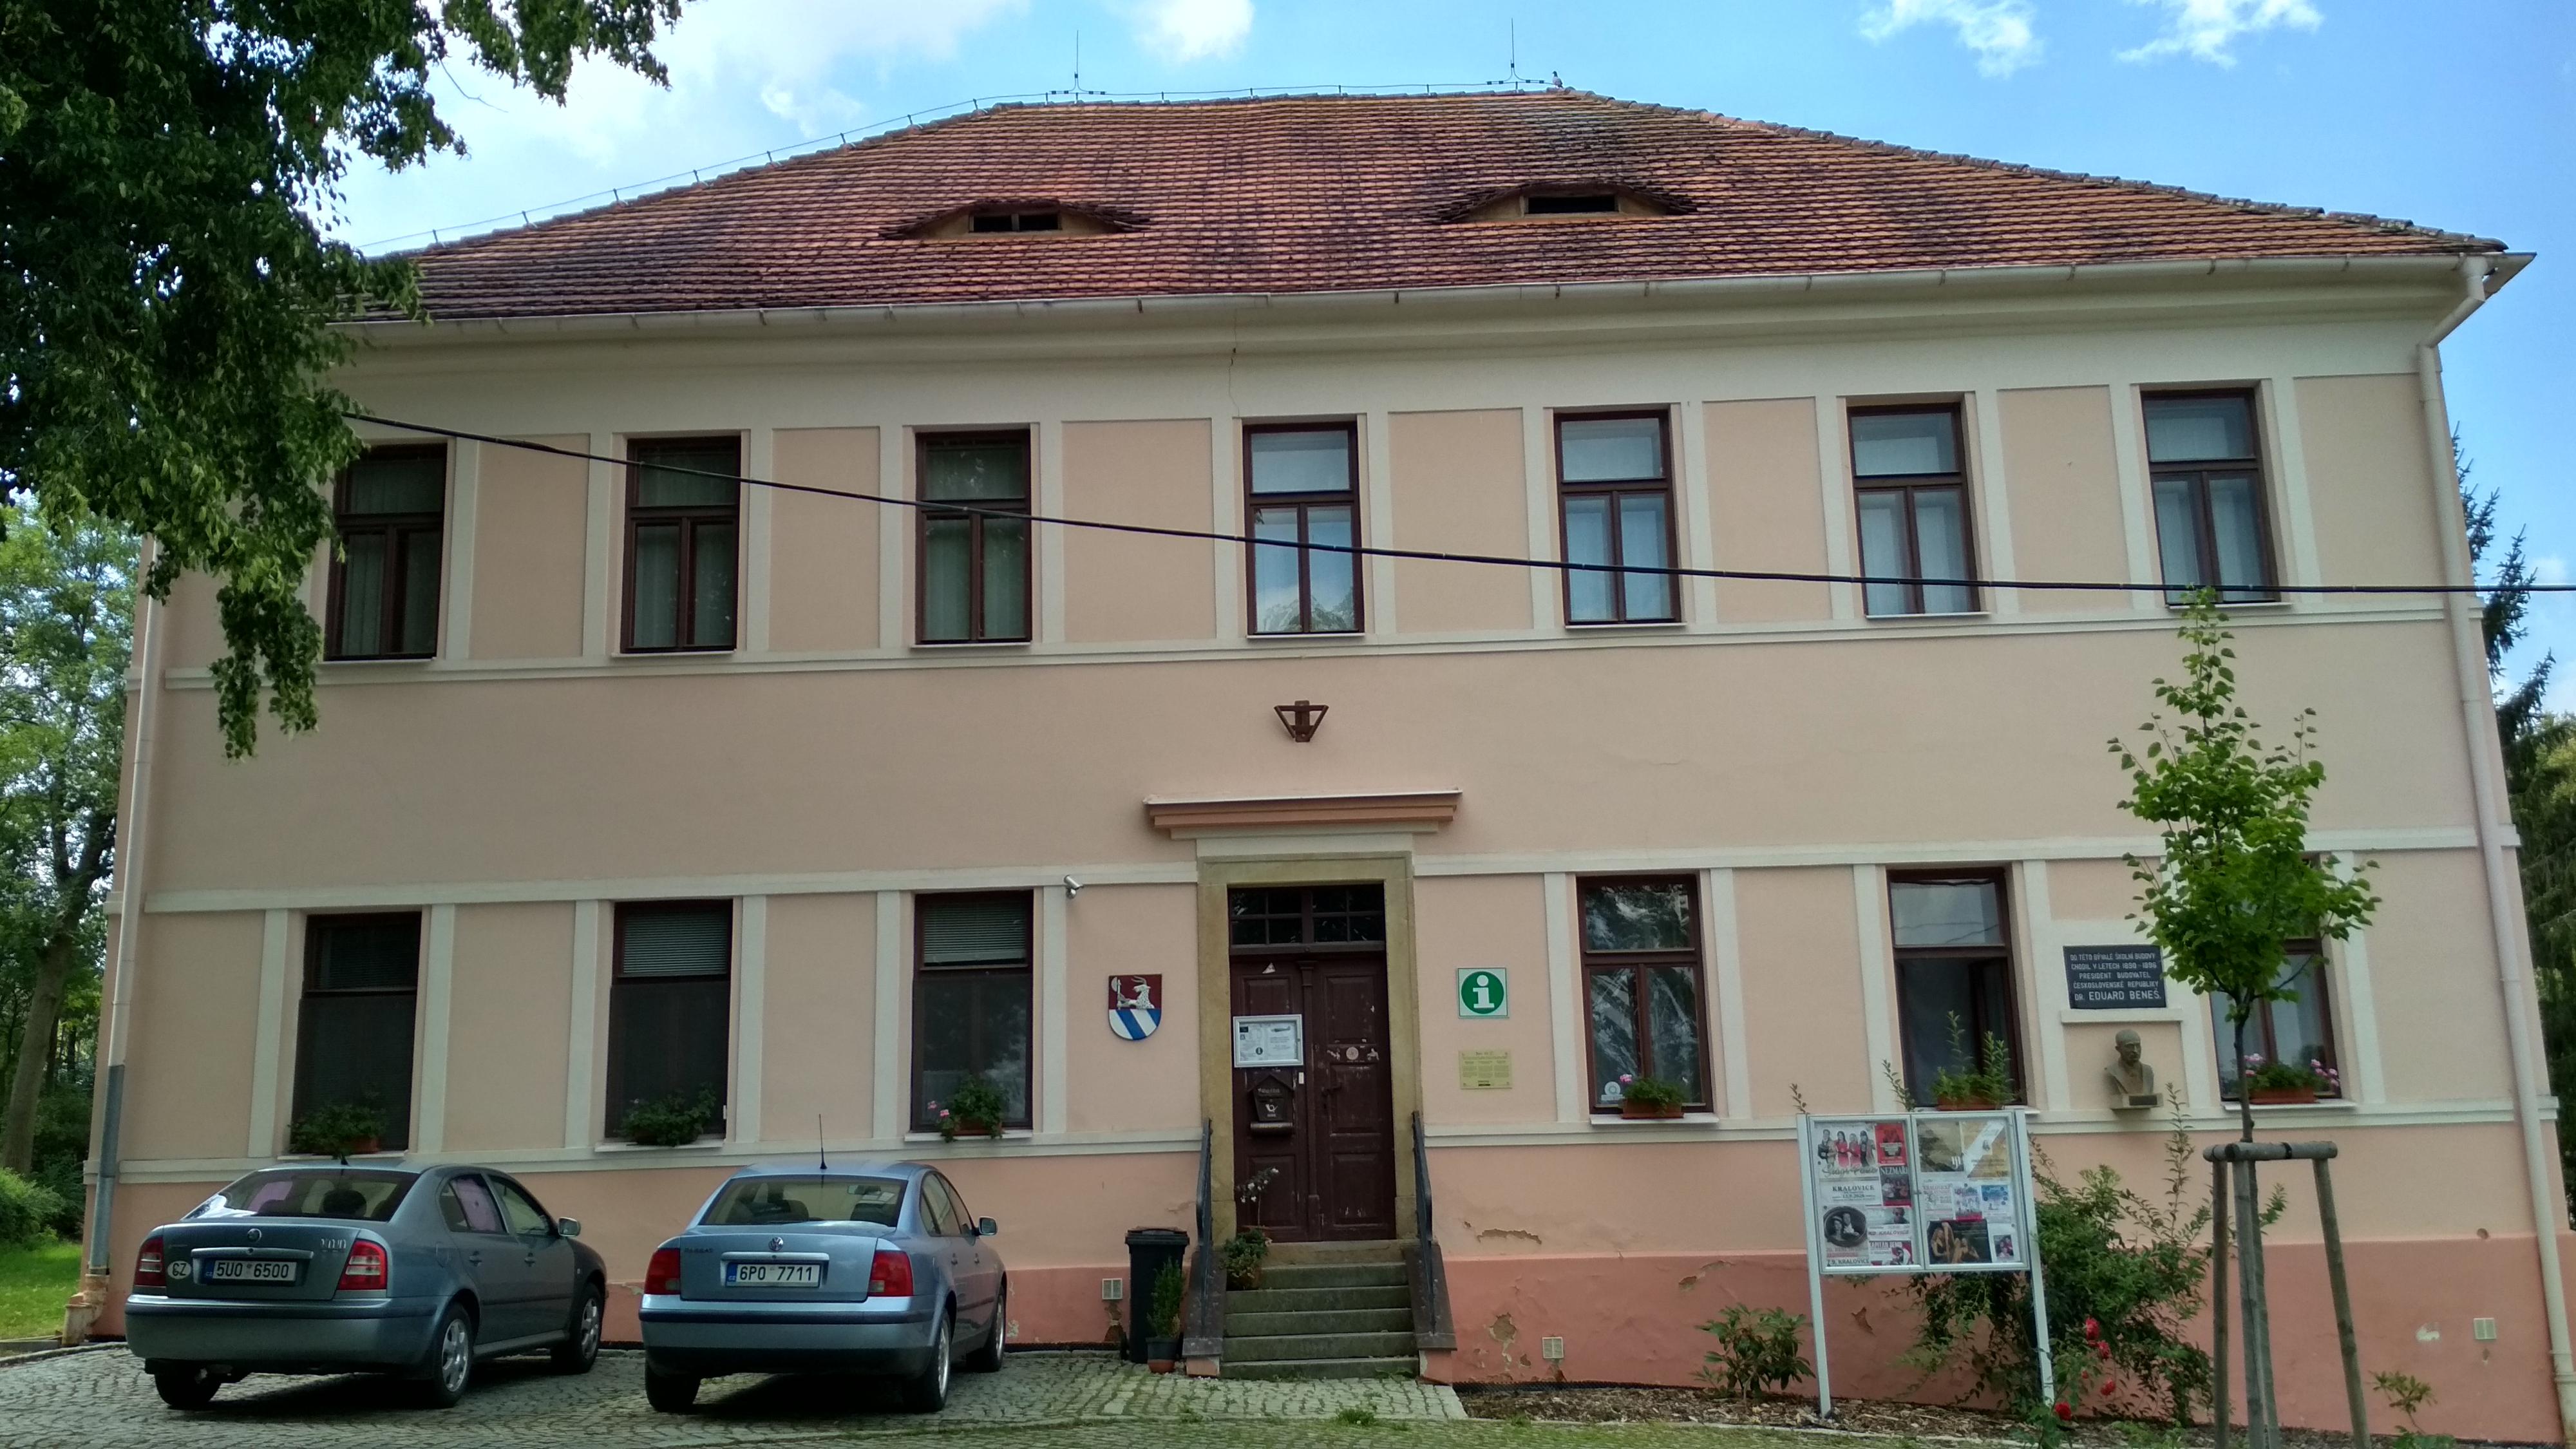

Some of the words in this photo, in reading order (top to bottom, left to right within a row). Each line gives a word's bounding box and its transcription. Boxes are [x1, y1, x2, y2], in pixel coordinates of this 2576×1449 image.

[2073, 980, 2125, 989] ČESKOSLOVENSKÉ
[2088, 991, 2125, 1000] EDUARD
[216, 1262, 243, 1277] 5U0
[254, 1264, 289, 1278] 6500
[740, 1266, 766, 1280] 6P0
[777, 1266, 811, 1281] 7711
